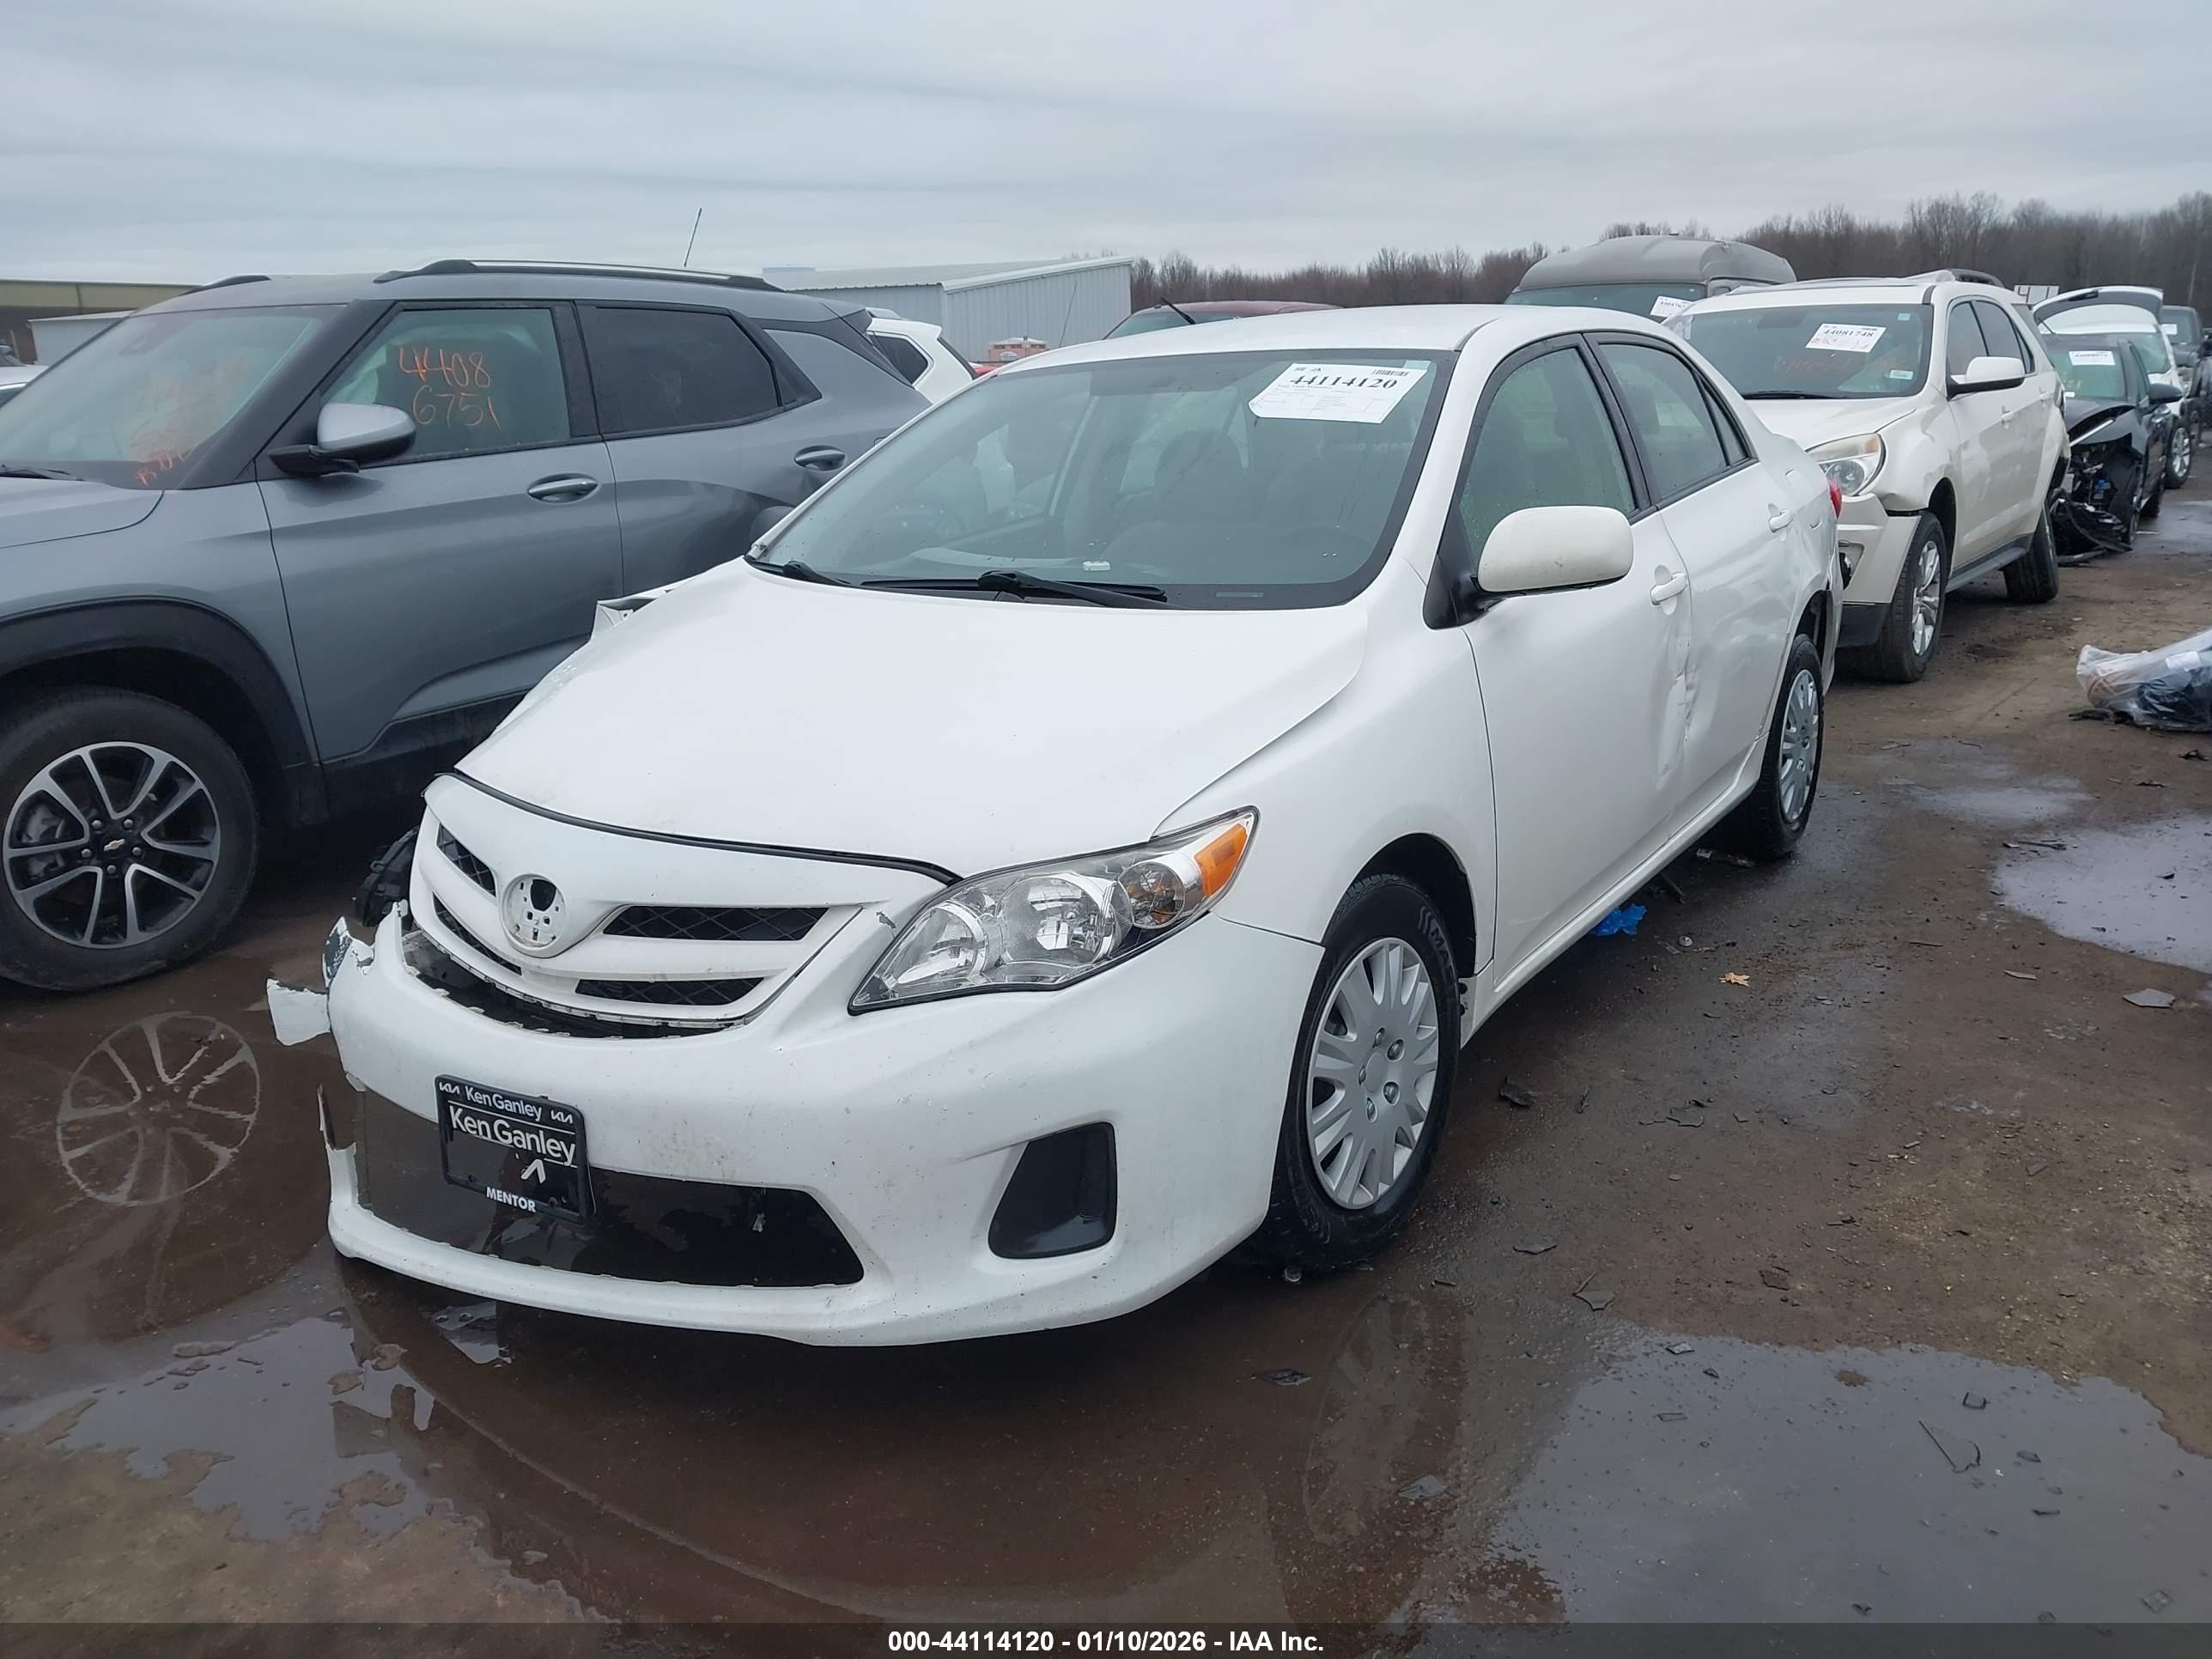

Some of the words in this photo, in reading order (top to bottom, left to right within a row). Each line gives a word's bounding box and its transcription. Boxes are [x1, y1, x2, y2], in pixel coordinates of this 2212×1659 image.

[398, 347, 490, 387] 4408
[1290, 374, 1398, 390] 44114120
[412, 385, 501, 429] 6751
[492, 1094, 543, 1121] Ganley
[449, 1105, 491, 1141] Ken
[493, 1119, 576, 1167] Ganley
[486, 1187, 536, 1212] MENTOR
